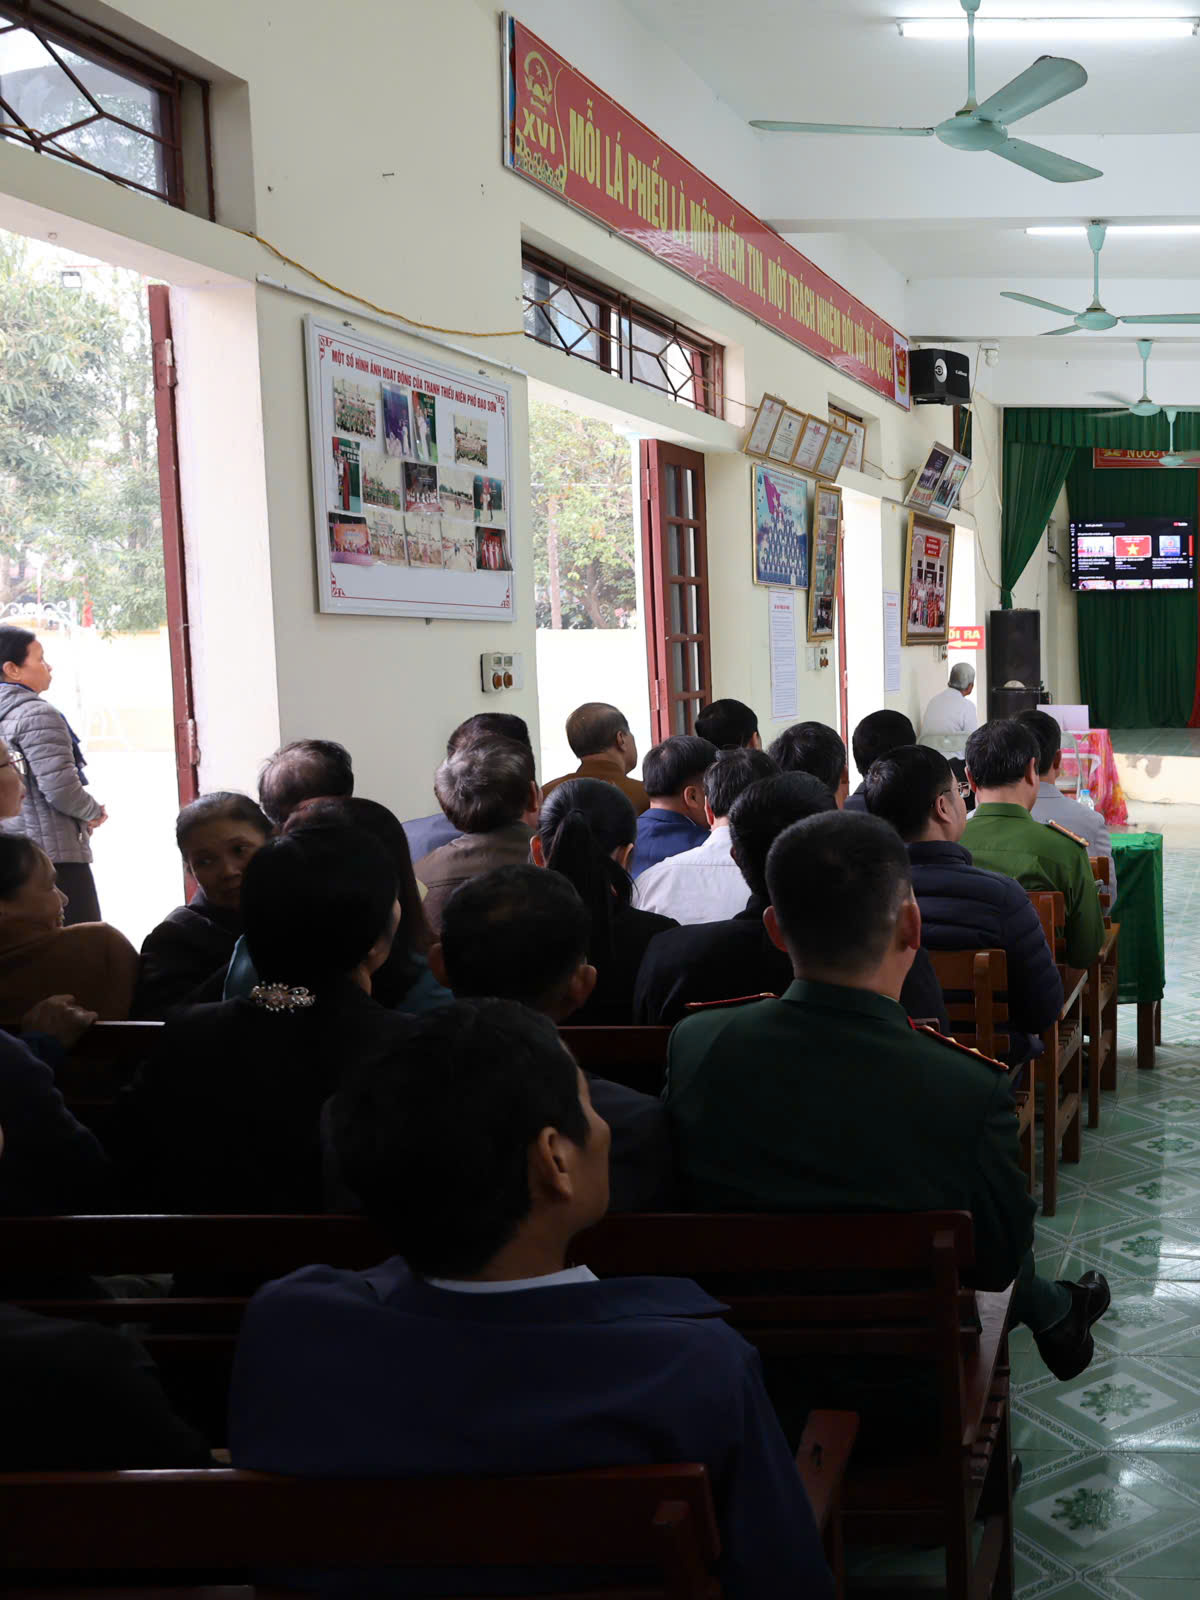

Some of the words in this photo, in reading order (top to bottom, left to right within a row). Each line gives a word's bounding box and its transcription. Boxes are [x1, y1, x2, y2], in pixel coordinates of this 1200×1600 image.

[523, 107, 556, 155] XVI
[569, 98, 600, 189] MỖI
[605, 131, 624, 205] LÁ
[627, 156, 668, 233] PHIẾU
[672, 180, 686, 245] LÀ
[690, 198, 715, 272] MỘT
[767, 256, 787, 318] MỘT
[788, 273, 815, 332] TRÁCH
[331, 349, 344, 366] MỘT
[346, 352, 354, 368] SỐ
[355, 355, 369, 373] HÌNH
[370, 359, 382, 377] ẢNH
[412, 374, 422, 389] CỦA
[424, 380, 440, 396] THANH
[441, 385, 454, 400] THIẾU
[963, 630, 981, 639] RA
